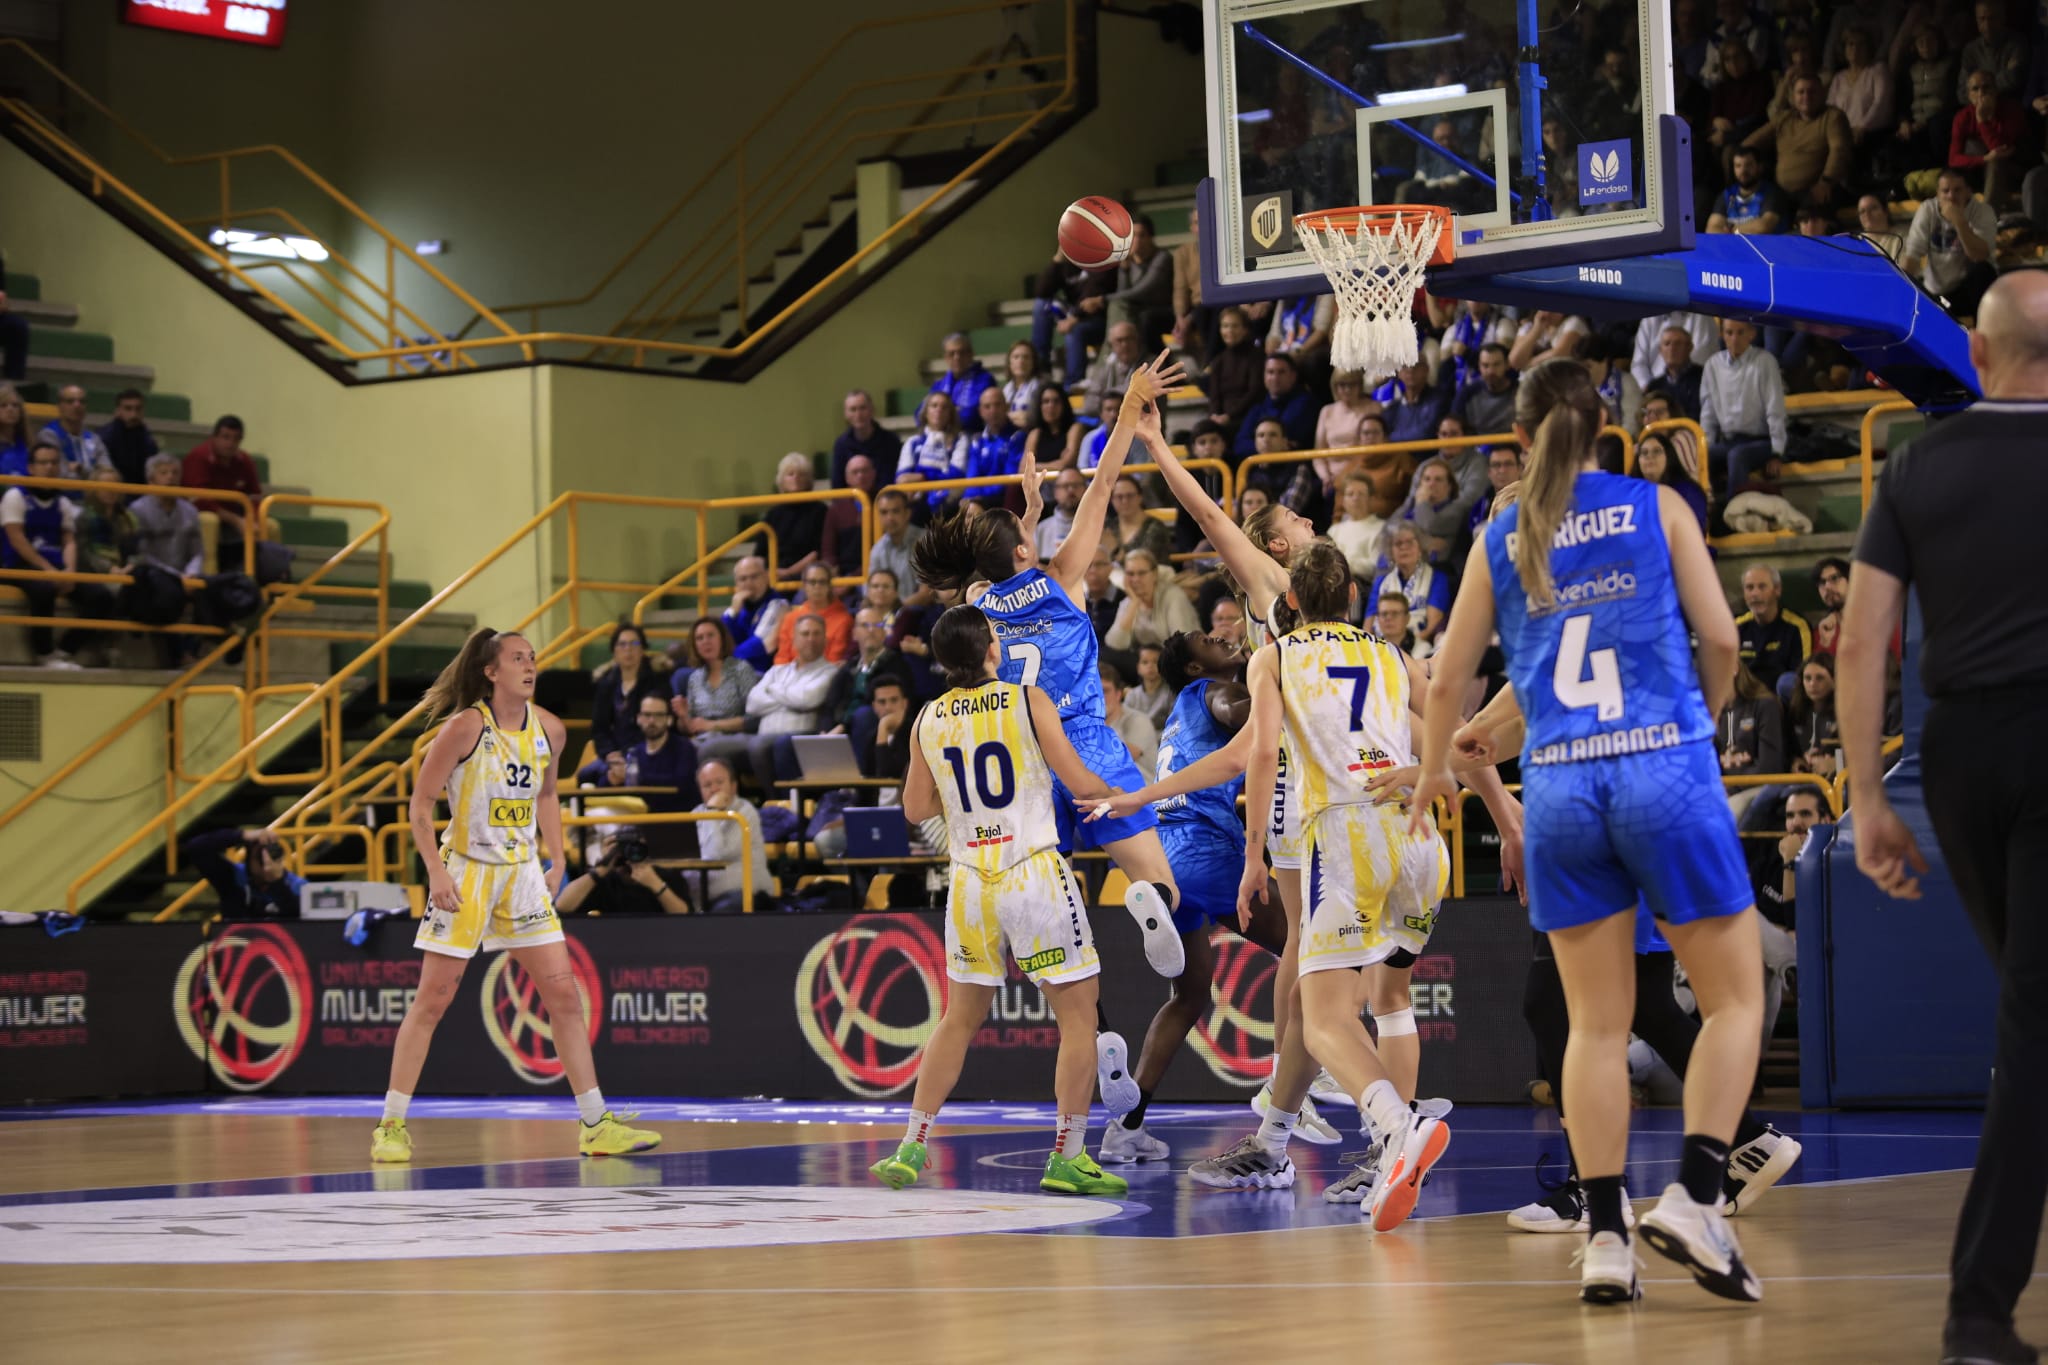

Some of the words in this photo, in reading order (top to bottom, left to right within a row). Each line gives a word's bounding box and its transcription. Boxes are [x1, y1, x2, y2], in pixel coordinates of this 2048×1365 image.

[1583, 187, 1595, 197] LF
[1596, 184, 1628, 195] endesa
[1578, 266, 1622, 285] MONDO
[1701, 271, 1743, 291] MONDO
[1505, 503, 1637, 562] RRÍGUEZ
[1553, 613, 1625, 722] 4
[935, 701, 947, 718] C.
[951, 691, 1009, 716] GRANDE
[1325, 666, 1371, 732] 7
[1357, 747, 1389, 761] Pujo
[1530, 722, 1682, 764] SALAMANCA
[506, 762, 531, 788] 32
[943, 741, 1016, 813] 10
[1271, 747, 1287, 838] taurus
[974, 825, 1002, 839] Pujol
[610, 967, 708, 990] UNIVERSO
[611, 991, 708, 1022] MUJER
